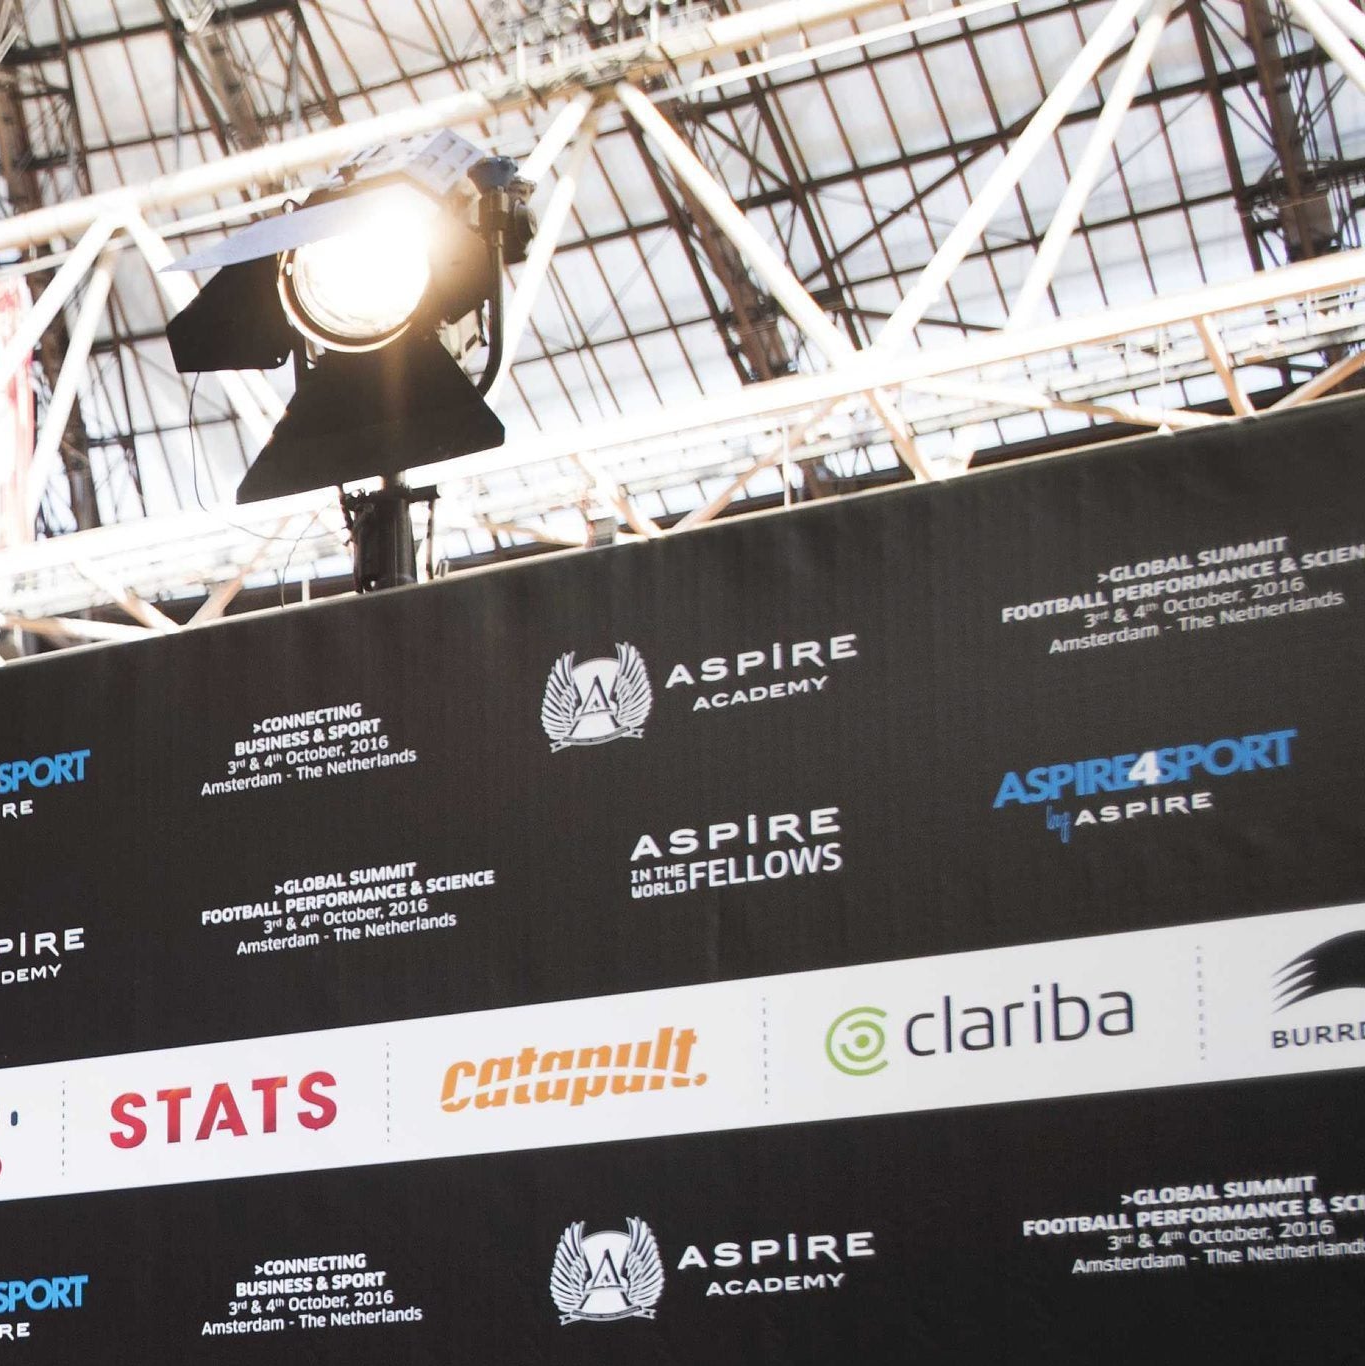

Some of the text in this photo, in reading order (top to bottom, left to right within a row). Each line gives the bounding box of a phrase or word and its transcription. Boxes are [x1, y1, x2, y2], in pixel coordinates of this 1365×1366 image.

[664, 633, 858, 689] ASPIRE
[692, 675, 828, 712] ACADEMY
[227, 734, 389, 775] 3rd & 4th October, 2016
[234, 717, 382, 757] BUSINESS & SPORT
[200, 772, 282, 796] Amsterdam
[295, 764, 323, 781] The
[326, 748, 417, 776] Netherlands
[993, 729, 1296, 808] ASPIRE4SPORT
[630, 806, 841, 862] ASPIRE
[1046, 791, 1213, 844] by ASPIRE
[630, 863, 686, 884] IN THE
[631, 879, 688, 899] WORLD
[689, 842, 843, 890] FELLOWS
[904, 982, 1136, 1057] clariba
[110, 1070, 338, 1150] STATS
[677, 1231, 875, 1270] ASPIRE
[705, 1272, 845, 1297] ACADEMY
